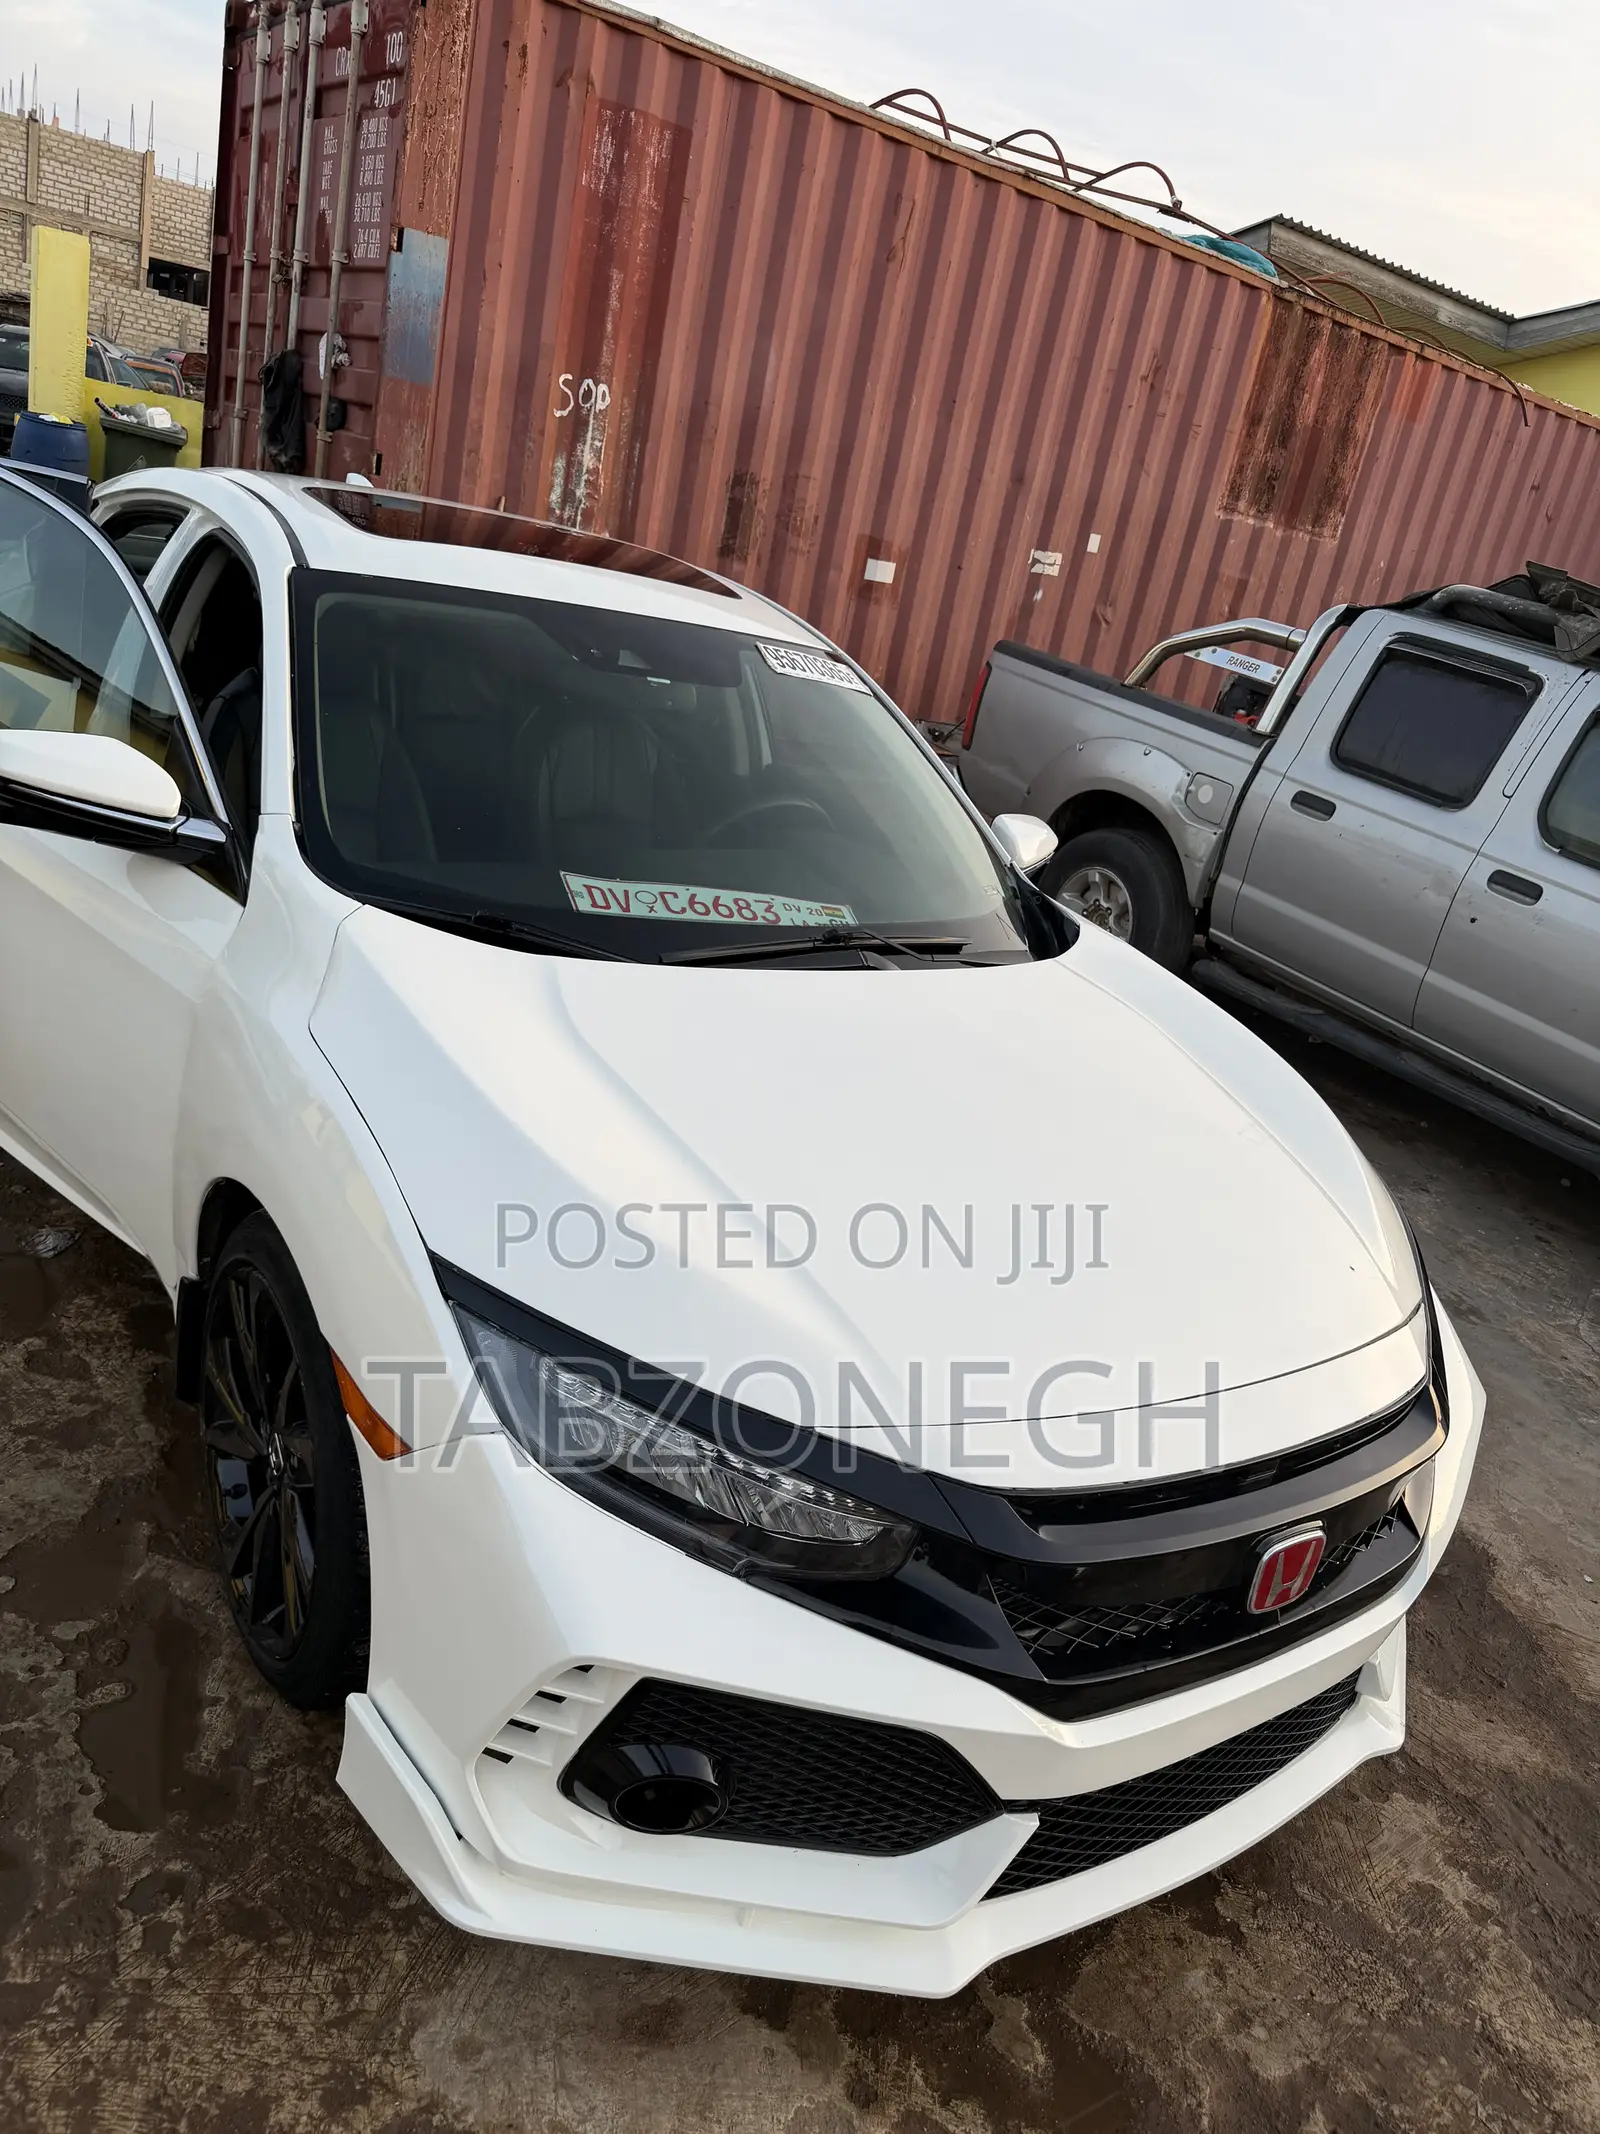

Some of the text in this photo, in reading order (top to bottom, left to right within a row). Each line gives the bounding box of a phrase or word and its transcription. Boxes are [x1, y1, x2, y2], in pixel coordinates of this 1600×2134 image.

[374, 77, 396, 108] 45G1
[323, 139, 338, 155] GROSS
[1226, 655, 1260, 674] RANGER
[582, 884, 631, 913] DV
[658, 891, 782, 925] C6683
[782, 902, 824, 916] DV 20
